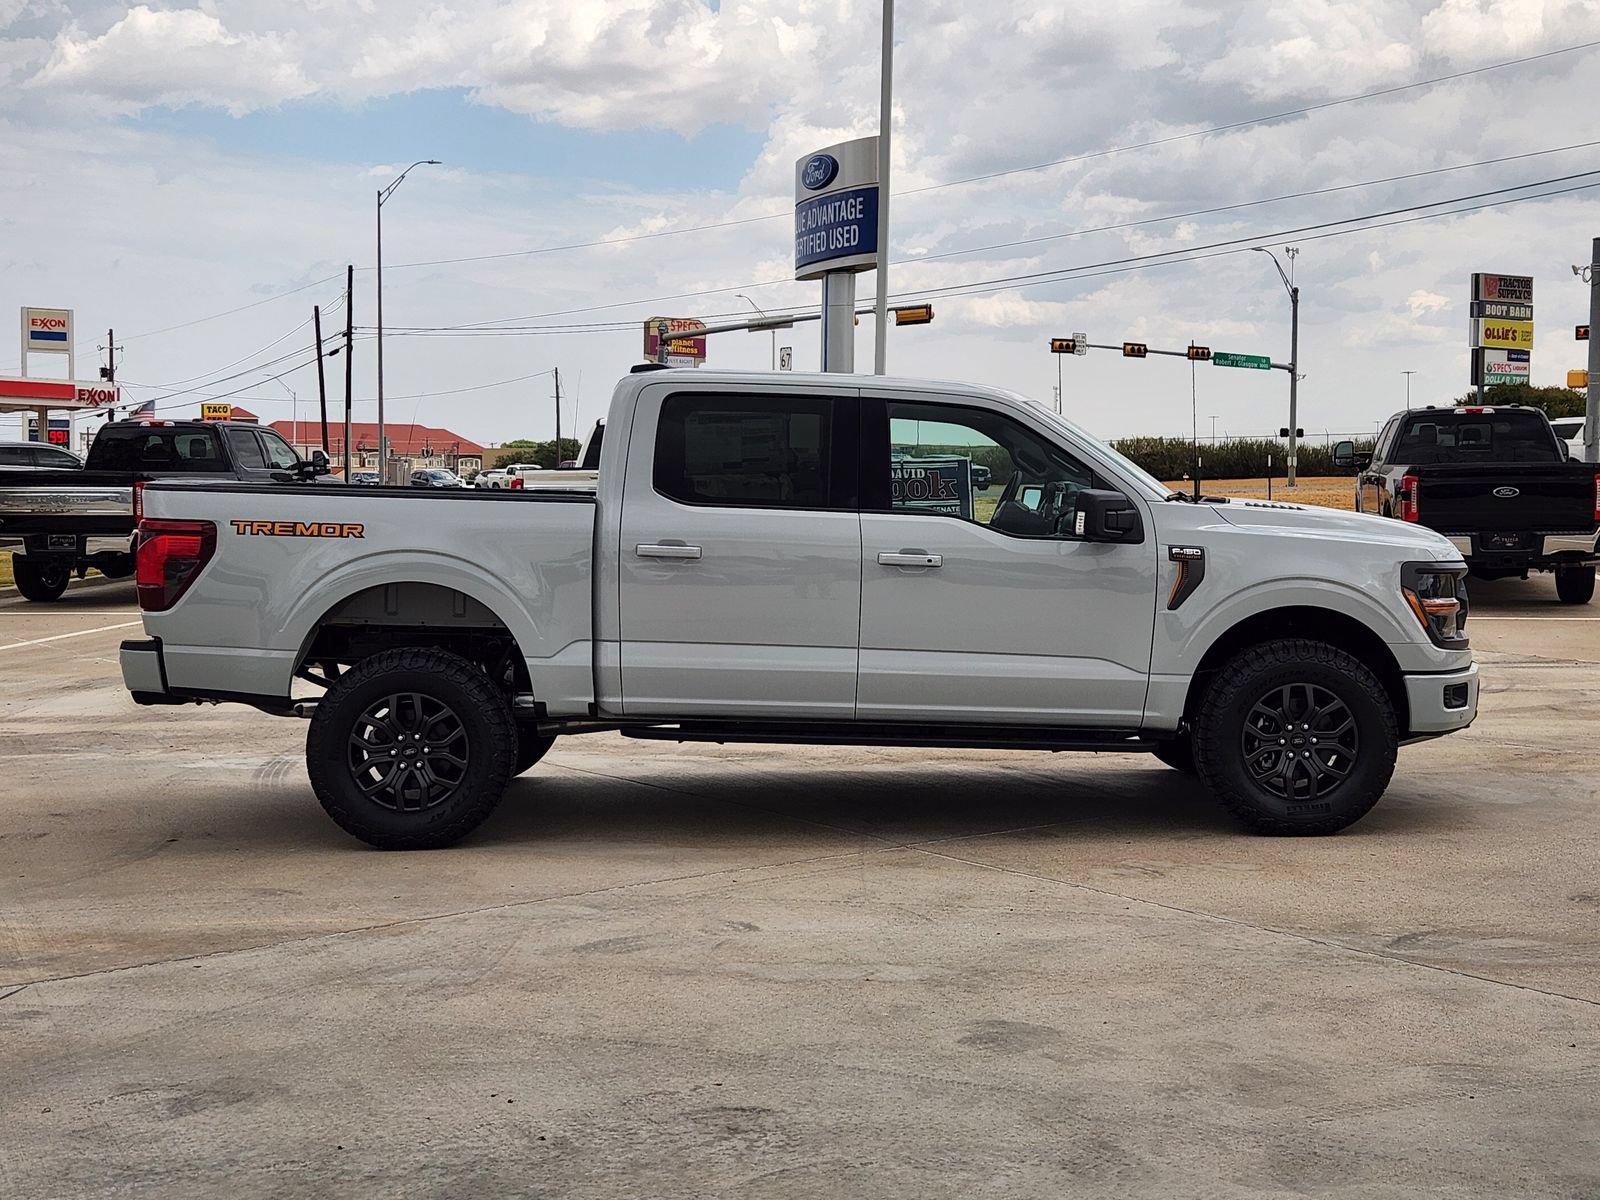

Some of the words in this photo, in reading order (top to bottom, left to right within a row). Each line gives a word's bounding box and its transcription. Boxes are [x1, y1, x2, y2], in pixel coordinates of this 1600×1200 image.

[805, 160, 826, 185] Ford
[796, 211, 806, 234] LUE
[806, 197, 864, 232] ADVANTAGE
[796, 231, 827, 257] ERTIFIED
[829, 224, 860, 250] USED
[1498, 278, 1532, 290] TRACTOR
[1497, 288, 1522, 299] SUPPLY
[1485, 304, 1508, 316] BOOT
[1509, 306, 1532, 318] BARN
[31, 318, 66, 330] EXXON
[671, 339, 694, 347] planet
[781, 353, 791, 368] 67
[76, 387, 116, 407] EXXON
[206, 405, 229, 414] TACO
[892, 470, 959, 501] ook
[230, 520, 365, 539] TREMOR
